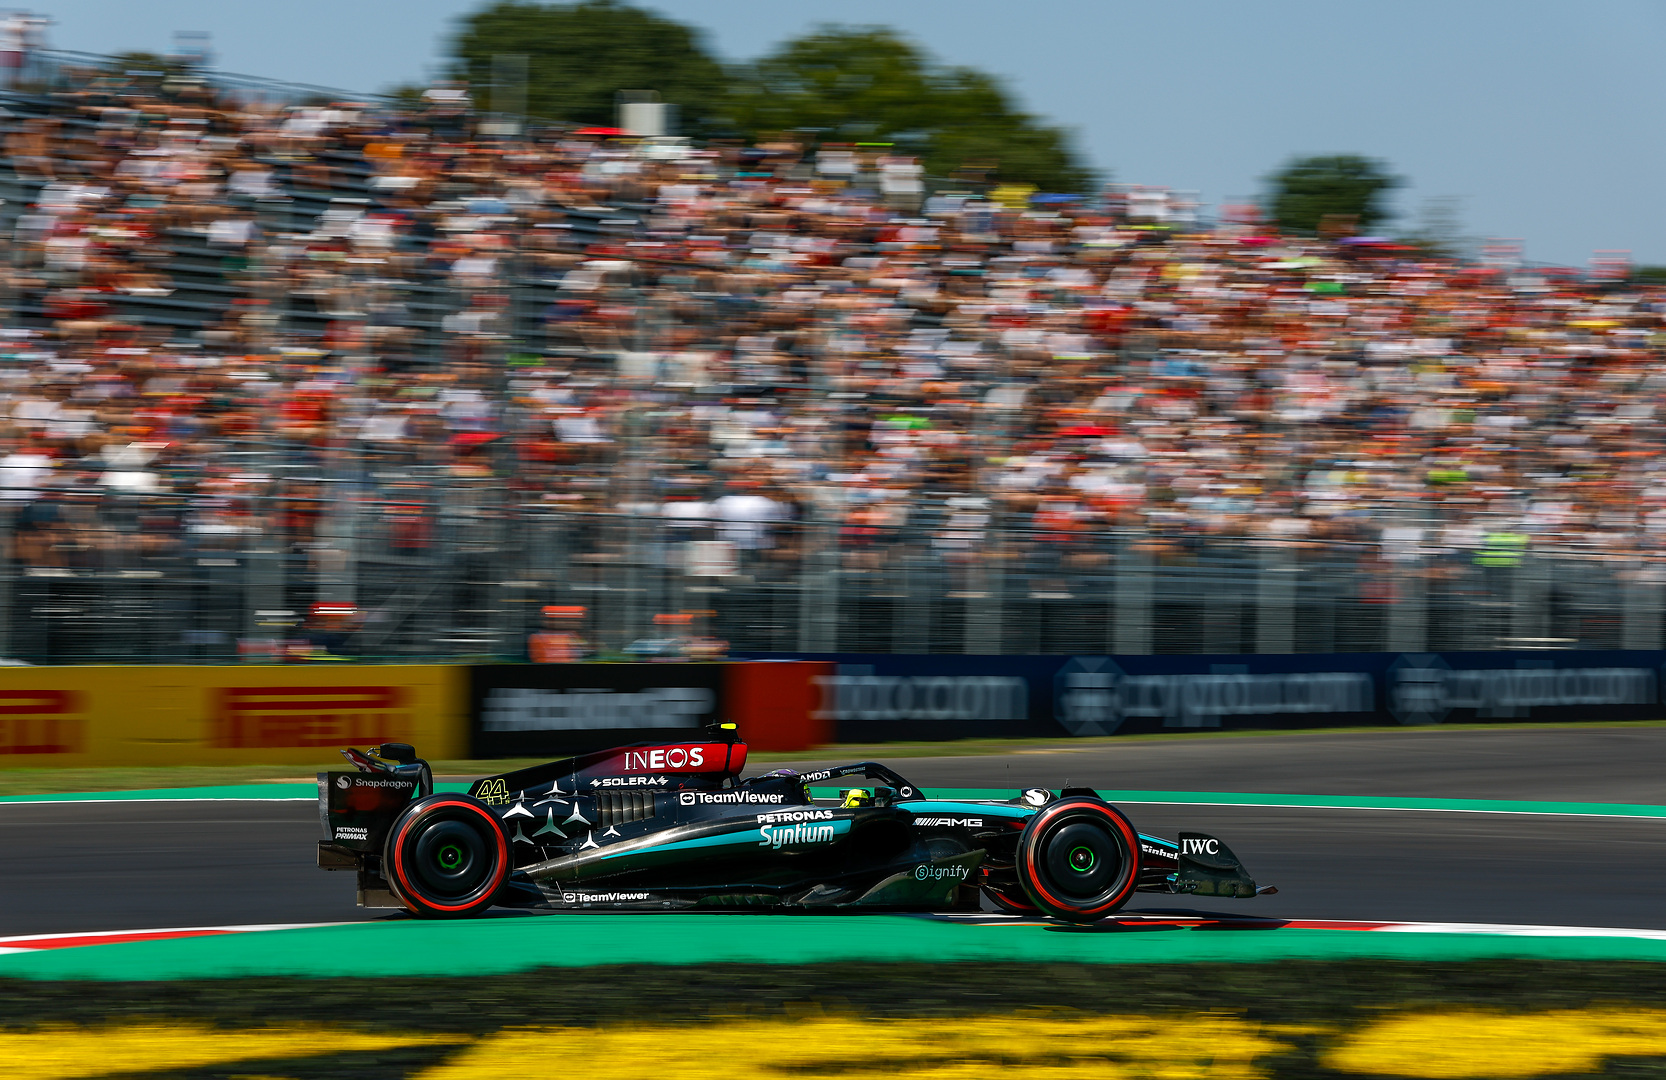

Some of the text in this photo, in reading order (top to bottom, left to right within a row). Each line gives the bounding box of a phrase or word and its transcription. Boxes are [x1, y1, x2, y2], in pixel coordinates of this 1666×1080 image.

[624, 747, 704, 771] INEOS
[355, 778, 413, 789] Snapdragon
[602, 776, 658, 787] SOLERA
[800, 771, 823, 784] AMD
[475, 778, 510, 805] 44
[696, 791, 784, 804] TeamViewer
[757, 810, 834, 824] PETRONAS
[934, 818, 983, 827] AMG
[335, 833, 368, 841] PRIMAX
[758, 822, 834, 850] Syntium
[1141, 843, 1179, 860] Einhel
[1181, 838, 1219, 855] IWC
[915, 864, 970, 881] signify
[577, 892, 650, 903] TeamViewer
